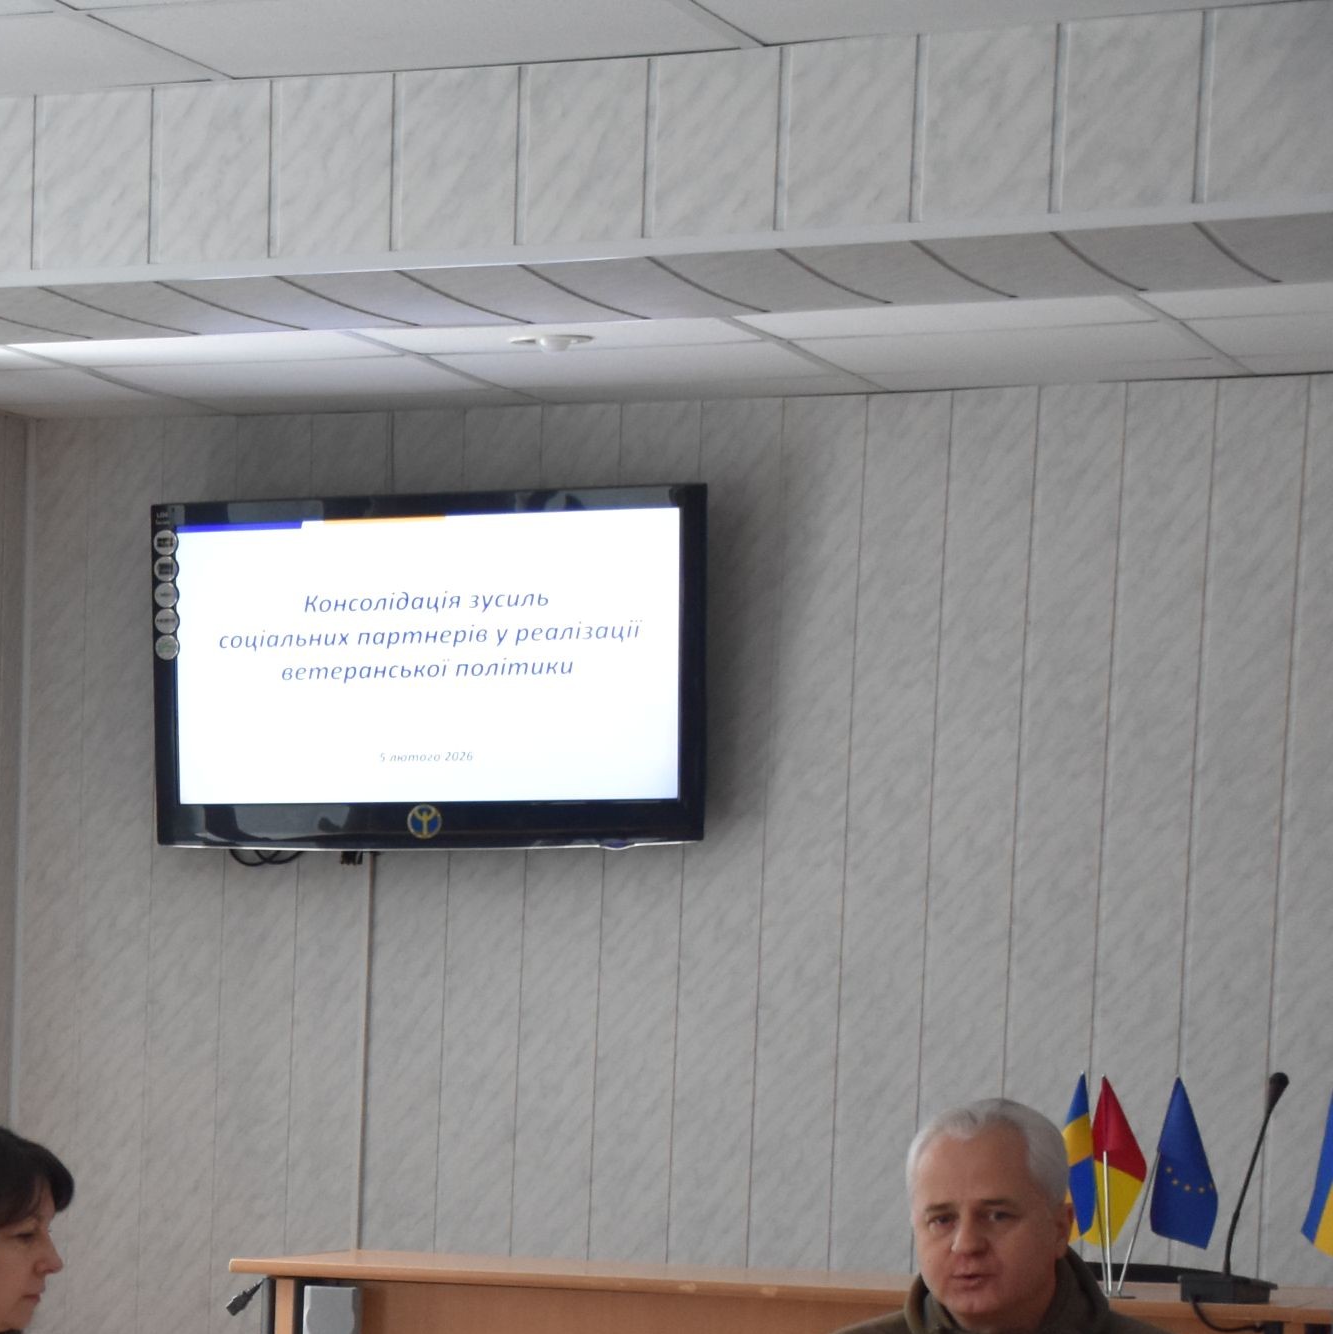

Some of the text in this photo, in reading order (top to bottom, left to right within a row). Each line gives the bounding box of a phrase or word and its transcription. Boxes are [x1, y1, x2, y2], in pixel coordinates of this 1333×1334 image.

[303, 590, 550, 613] Консолідація зусиль
[218, 619, 643, 652] соціальних партнерів у реалізації
[281, 656, 574, 684] ветеранської політики
[444, 750, 474, 762] 2026
